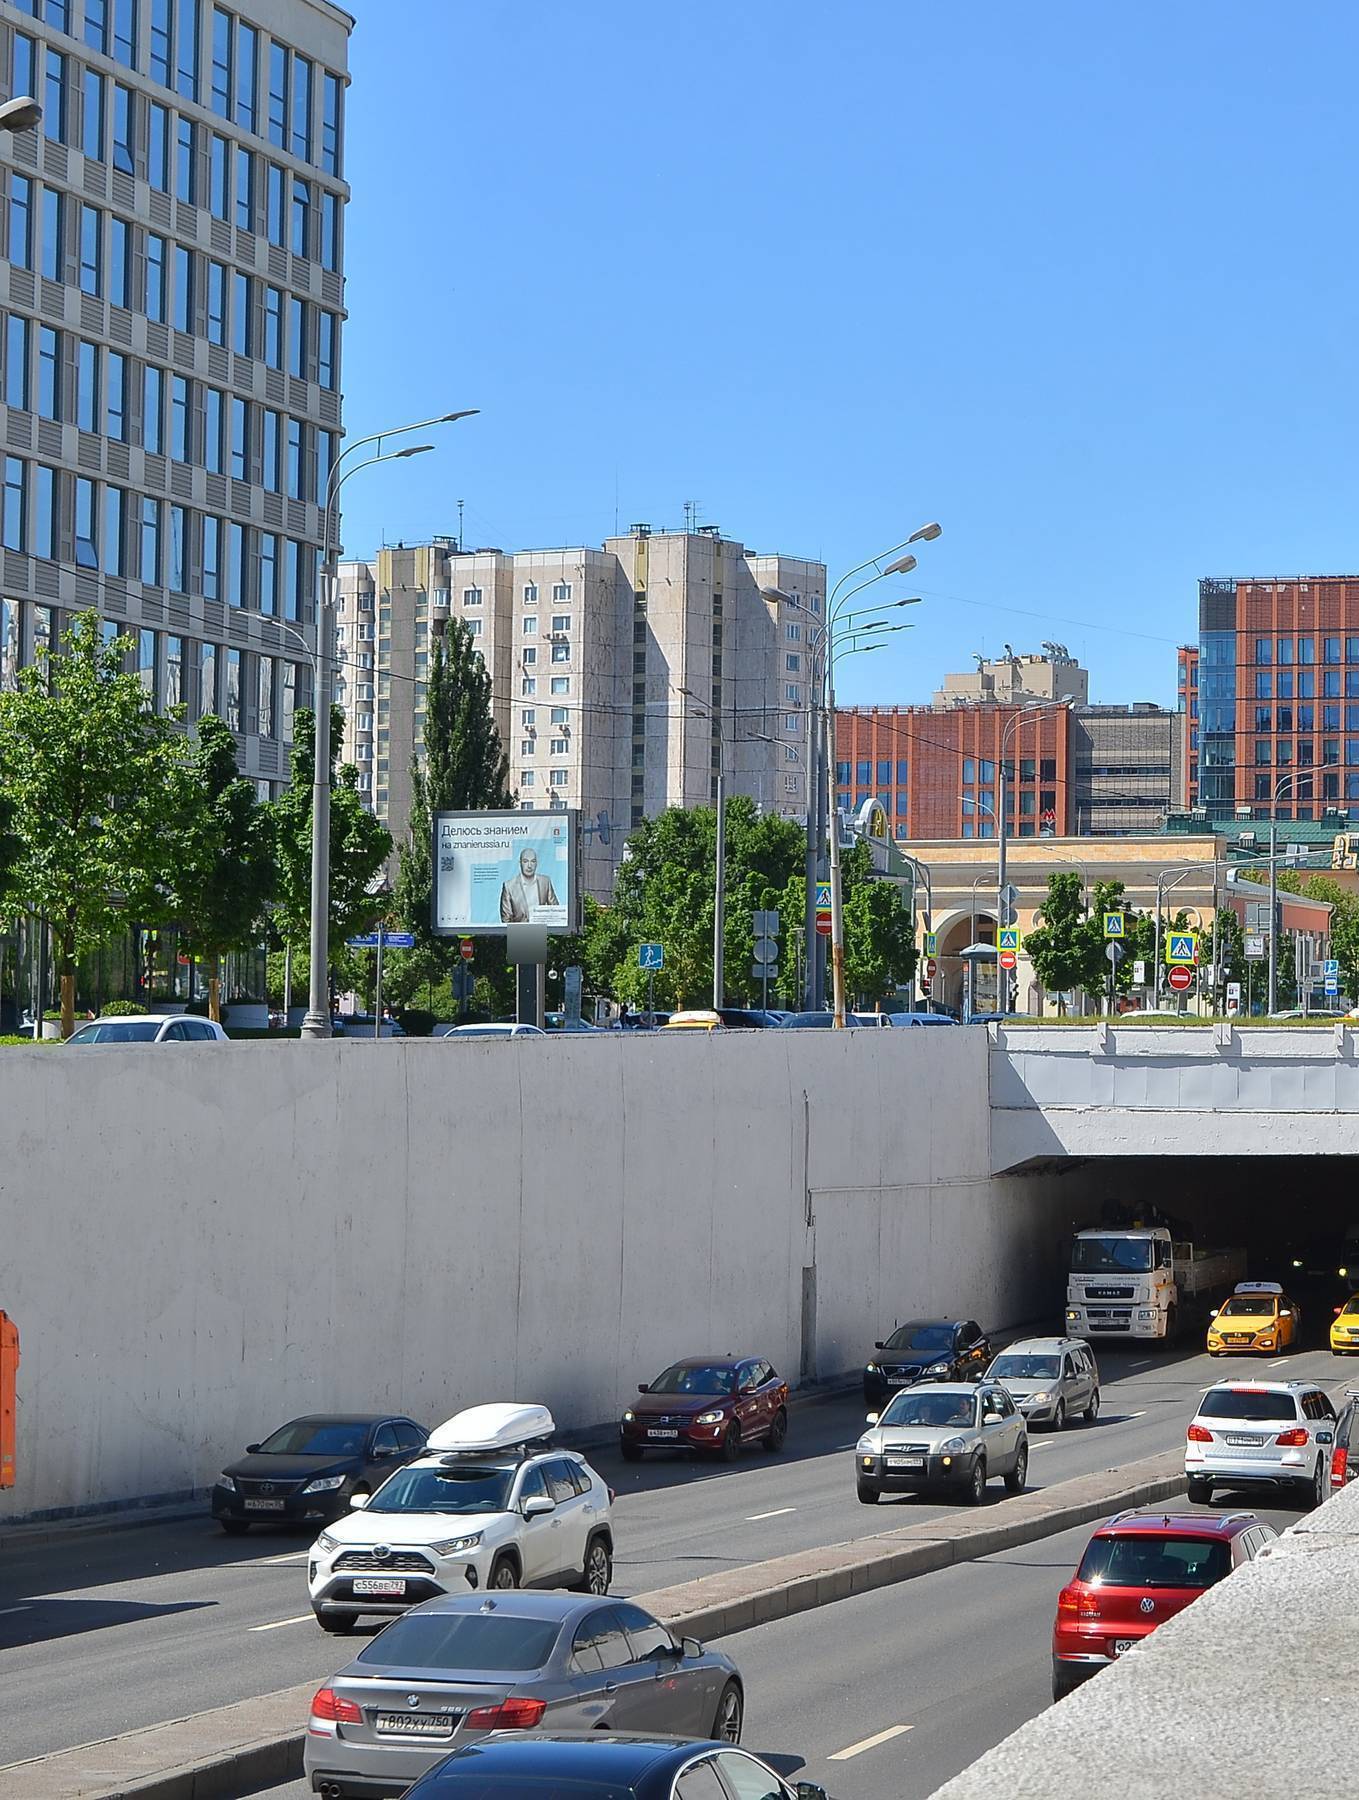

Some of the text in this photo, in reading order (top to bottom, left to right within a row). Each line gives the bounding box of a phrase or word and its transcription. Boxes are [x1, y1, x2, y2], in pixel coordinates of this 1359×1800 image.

[441, 825, 528, 838] Делюсь знанием
[453, 840, 510, 849] znanierussia.ru
[430, 1716, 448, 1726] 750
